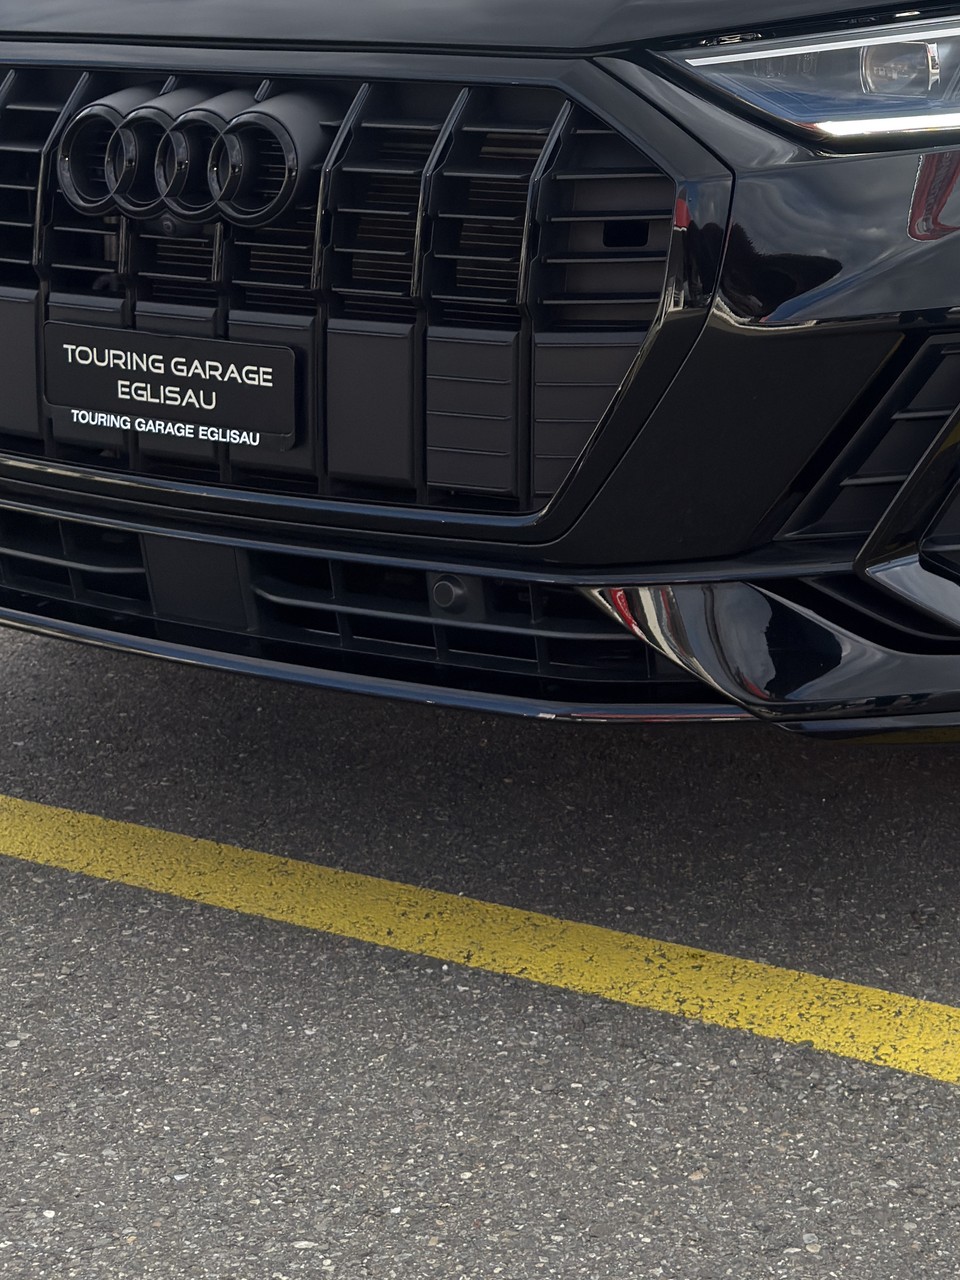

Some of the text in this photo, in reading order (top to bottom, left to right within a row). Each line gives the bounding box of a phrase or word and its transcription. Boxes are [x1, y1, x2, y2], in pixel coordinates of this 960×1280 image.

[63, 344, 273, 387] TOURING GARAGE
[117, 380, 217, 410] EGLISAU
[71, 409, 260, 446] TOURING GARAGE EGLISAU
